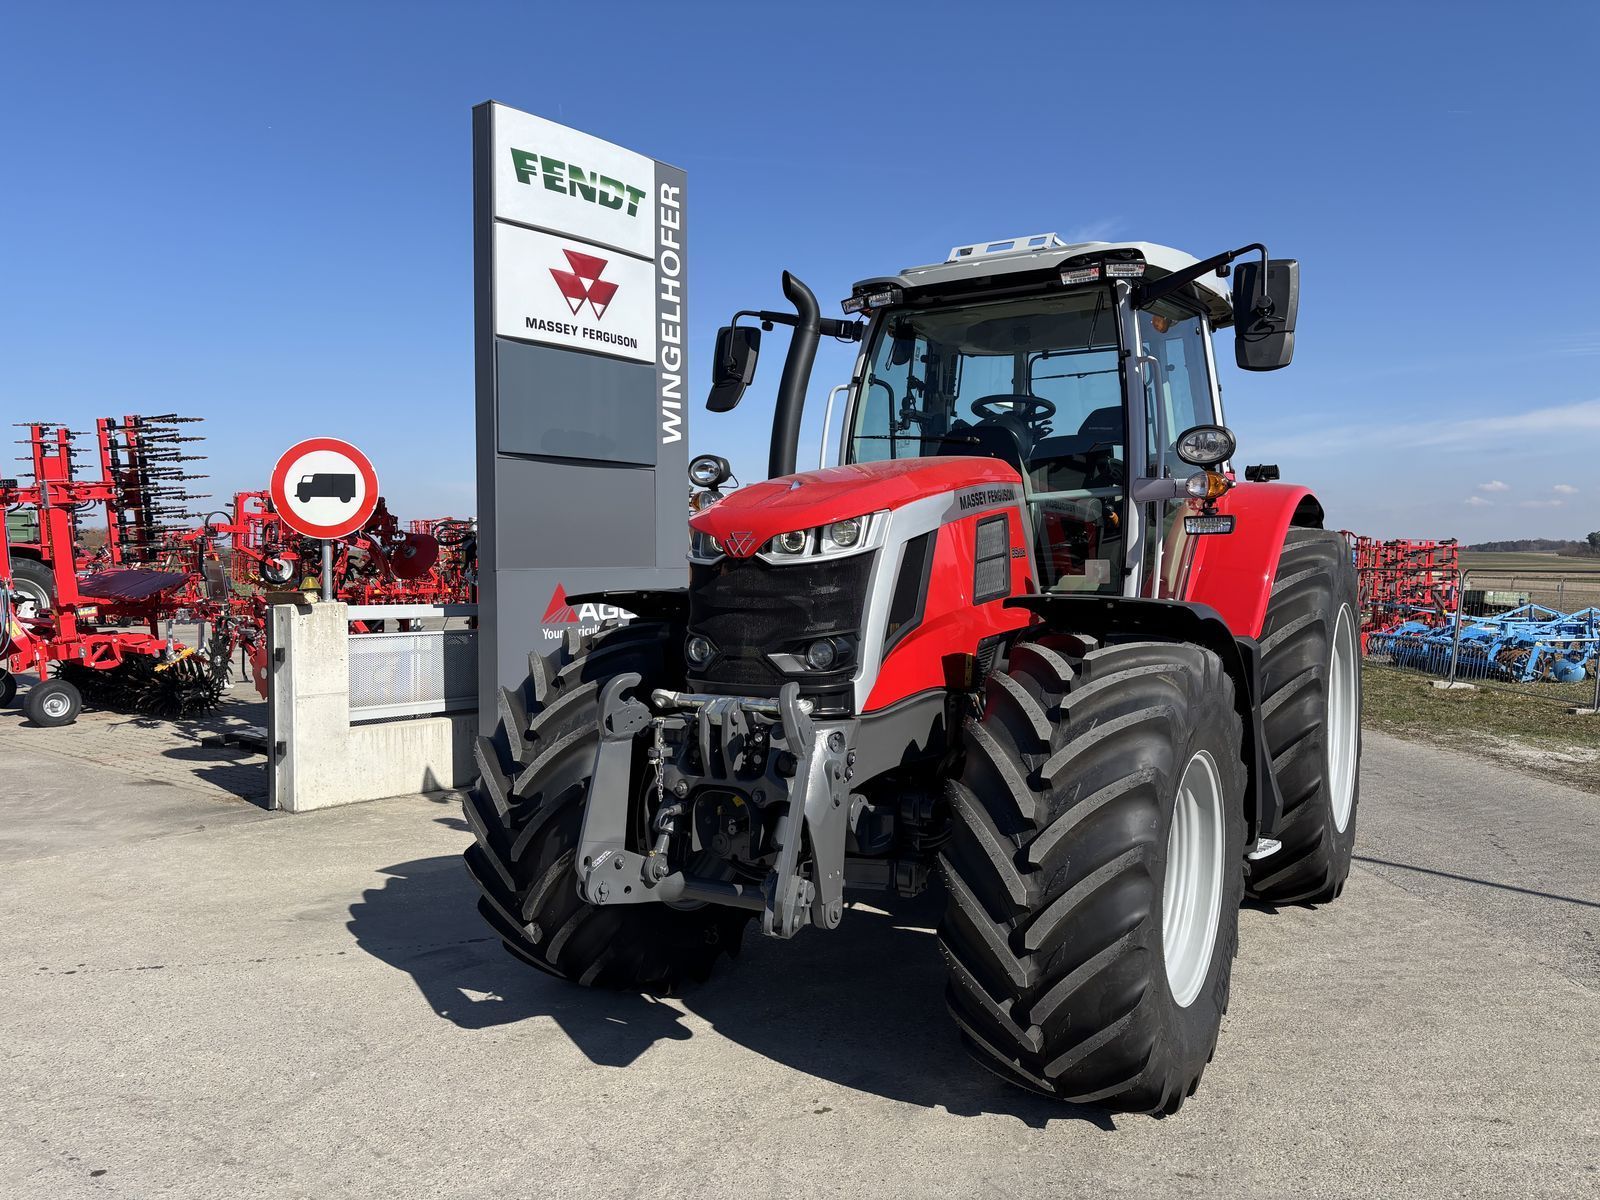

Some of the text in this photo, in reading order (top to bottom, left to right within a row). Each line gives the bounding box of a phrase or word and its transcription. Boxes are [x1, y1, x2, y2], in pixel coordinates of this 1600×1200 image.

[510, 147, 646, 217] FENDT
[660, 182, 682, 444] WINGELHOFER
[525, 316, 638, 349] MASSEY FERGUSON
[960, 491, 987, 510] MASSEY
[542, 628, 564, 640] Your
